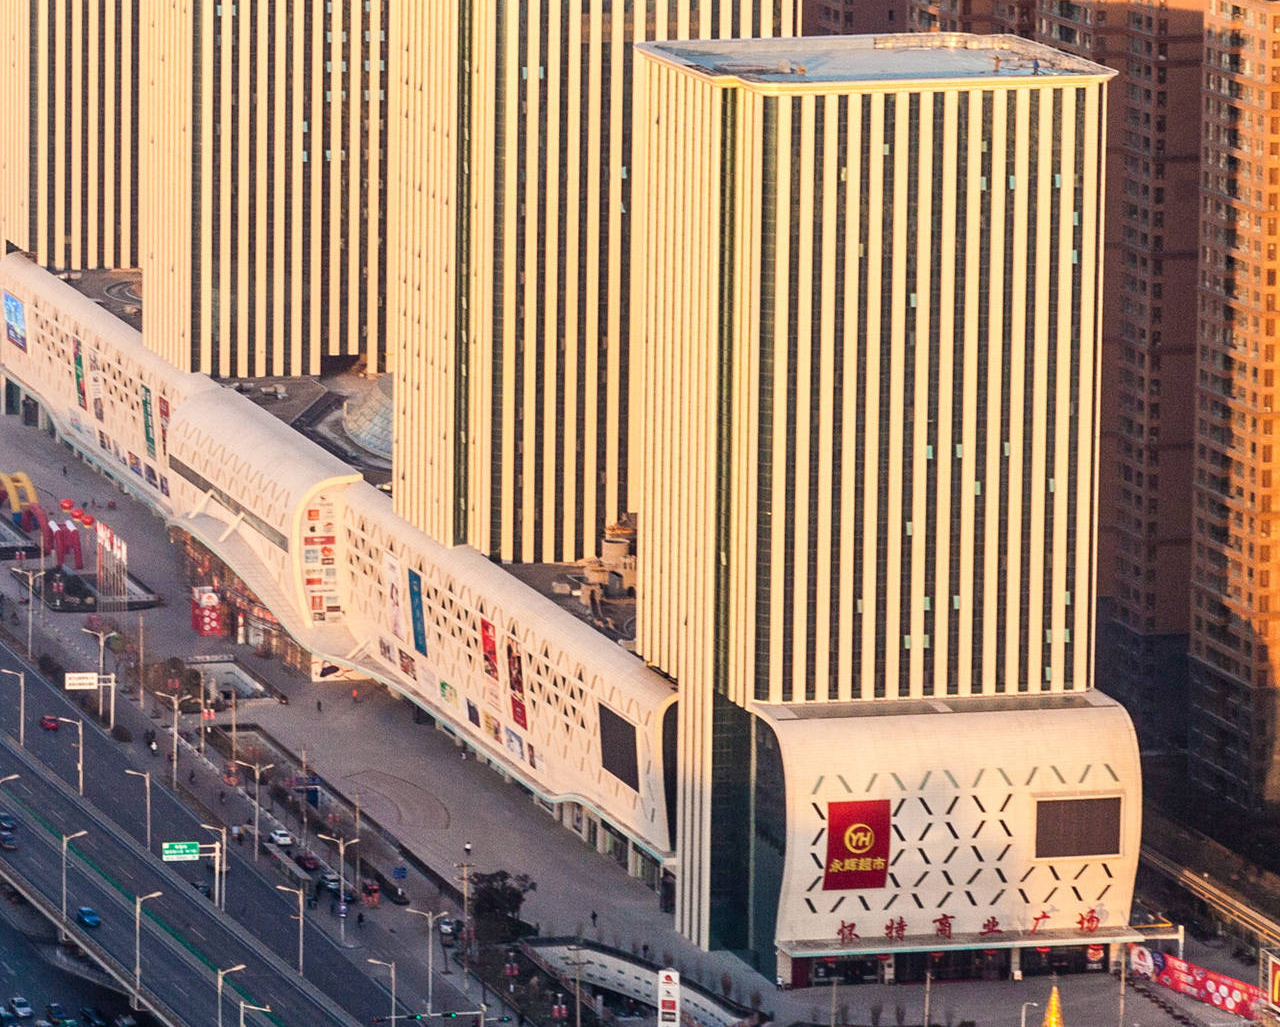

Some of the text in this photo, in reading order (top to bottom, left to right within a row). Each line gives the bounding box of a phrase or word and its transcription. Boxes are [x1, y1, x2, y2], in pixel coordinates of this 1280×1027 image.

[849, 831, 872, 847] YH
[829, 857, 886, 873] 永辉超市
[837, 909, 1101, 944] 怀特商业广场
